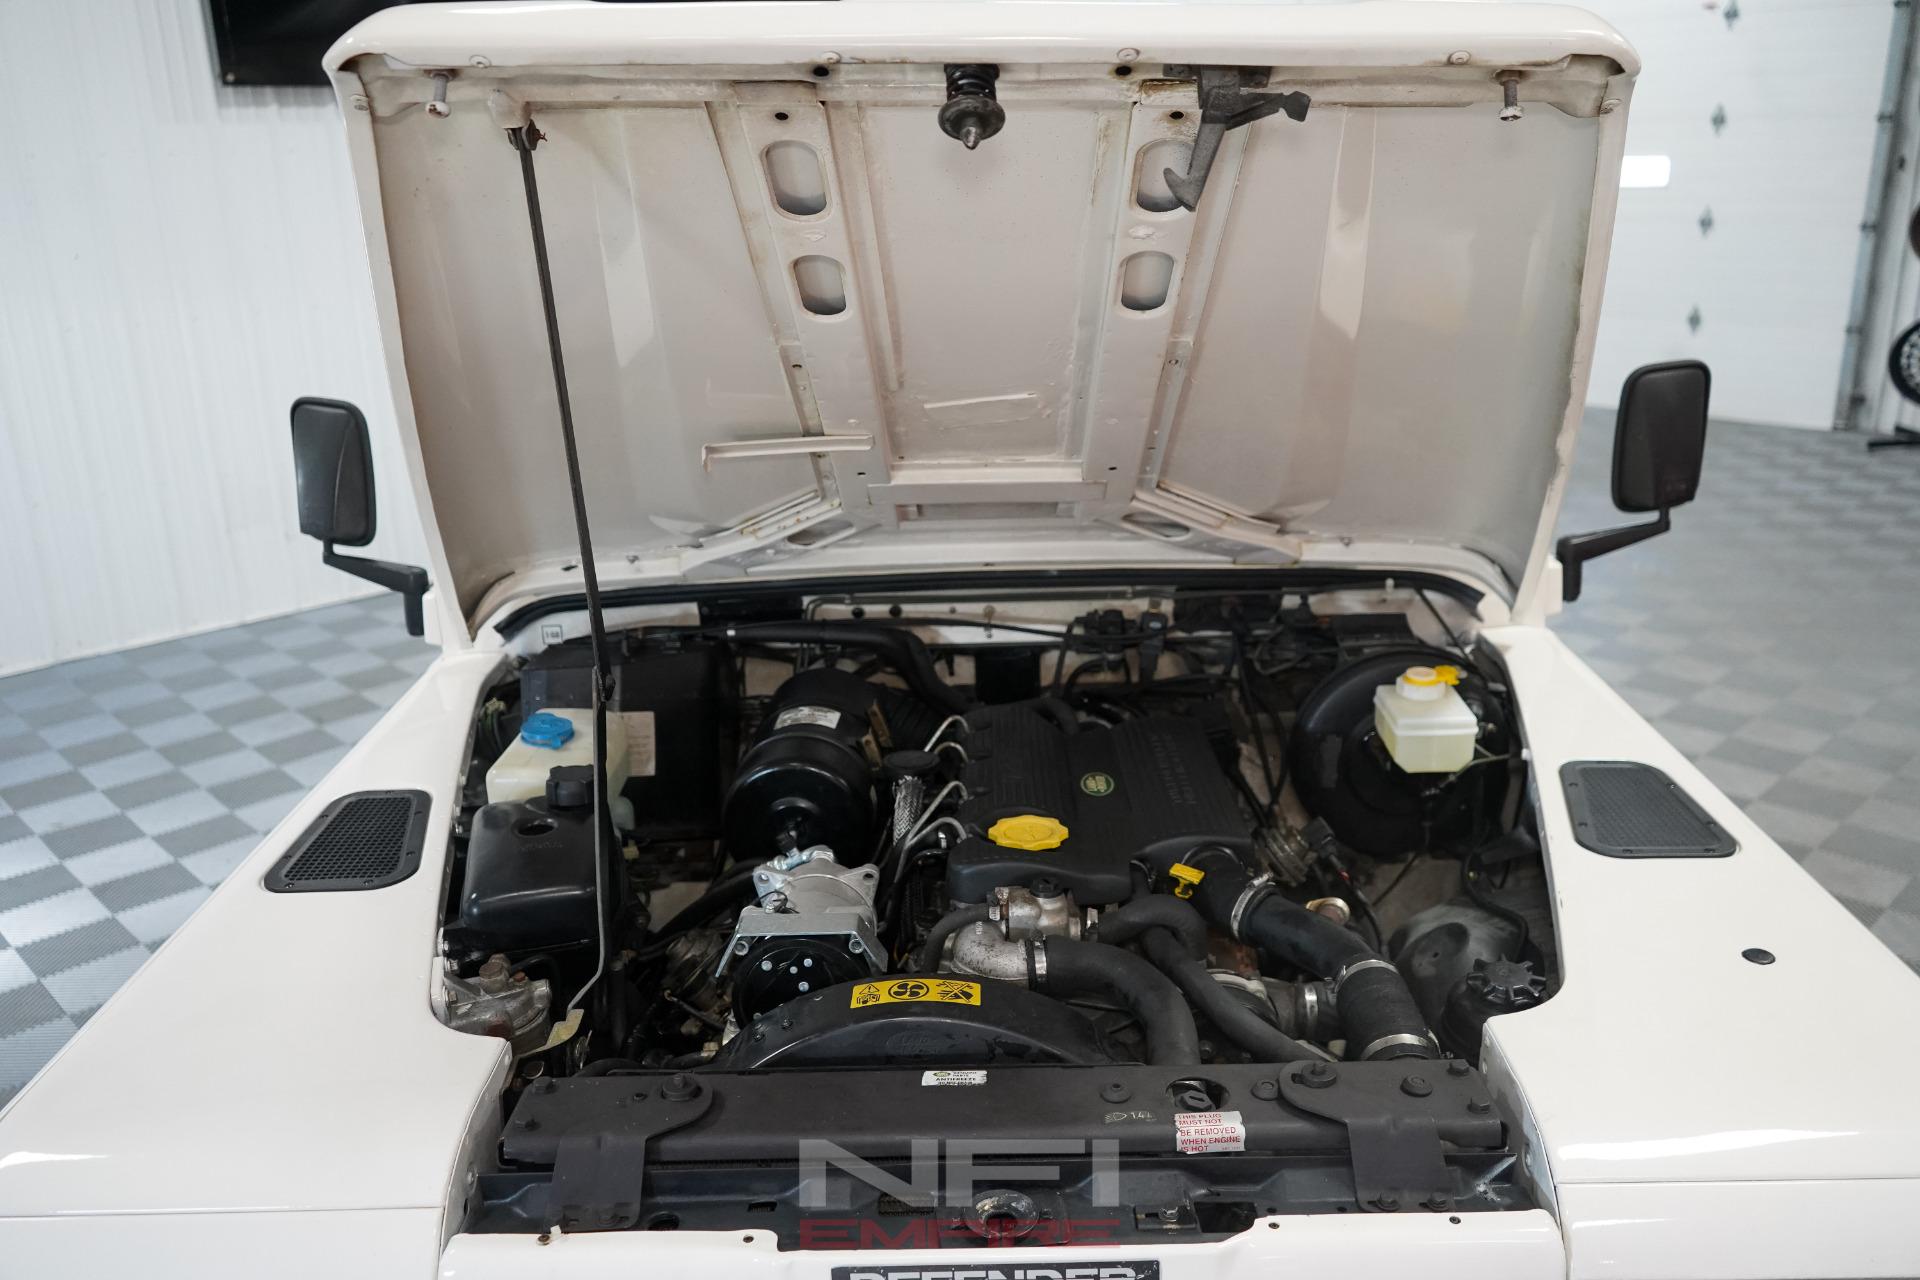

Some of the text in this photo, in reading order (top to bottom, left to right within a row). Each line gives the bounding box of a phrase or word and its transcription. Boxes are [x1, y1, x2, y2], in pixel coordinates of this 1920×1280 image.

[1180, 1127, 1237, 1137] BE REMOVED
[1208, 1136, 1241, 1144] ENGINE
